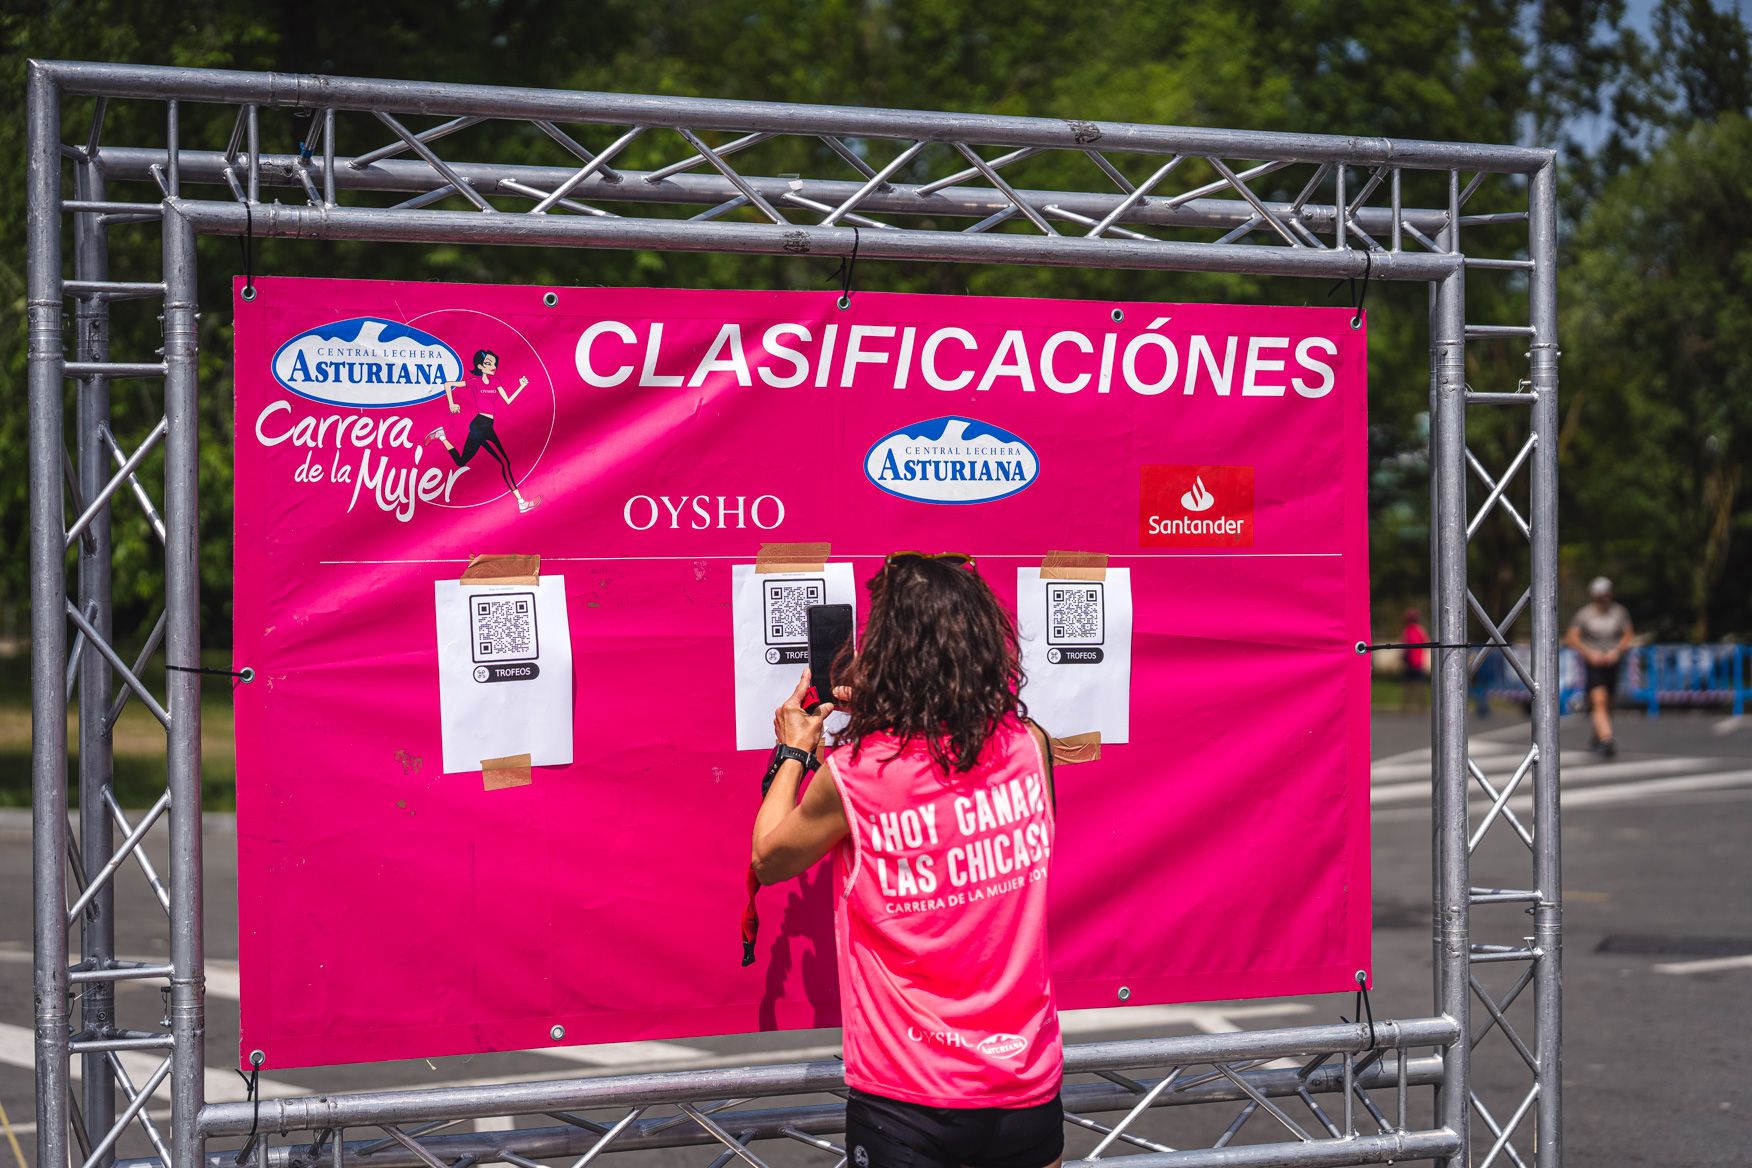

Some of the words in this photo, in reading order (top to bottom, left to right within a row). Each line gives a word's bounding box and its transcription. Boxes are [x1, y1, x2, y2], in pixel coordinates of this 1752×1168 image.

[287, 348, 448, 385] ASTURIANA
[317, 347, 377, 358] CENTRAL
[383, 348, 442, 359] LECHERA
[575, 317, 1338, 398] CLASIFICACIÓNES
[255, 400, 413, 448] Carrera
[878, 448, 1027, 481] ASTURIANA
[905, 446, 960, 455] CENTRAL
[966, 447, 1021, 455] LECHERA
[294, 450, 323, 483] de
[330, 449, 351, 483] la
[347, 446, 470, 522] Mujer
[623, 494, 786, 531] OYSHO
[1148, 515, 1244, 534] Santander
[495, 667, 531, 677] TROFEOS
[785, 651, 808, 659] TROFE
[1066, 651, 1097, 660] TROFEOS
[877, 854, 937, 897] LAS
[947, 821, 1050, 887] CHICAS!
[886, 899, 945, 914] CARRERA
[948, 893, 966, 906] DE
[969, 889, 984, 902] LA
[986, 876, 1025, 898] MUJER
